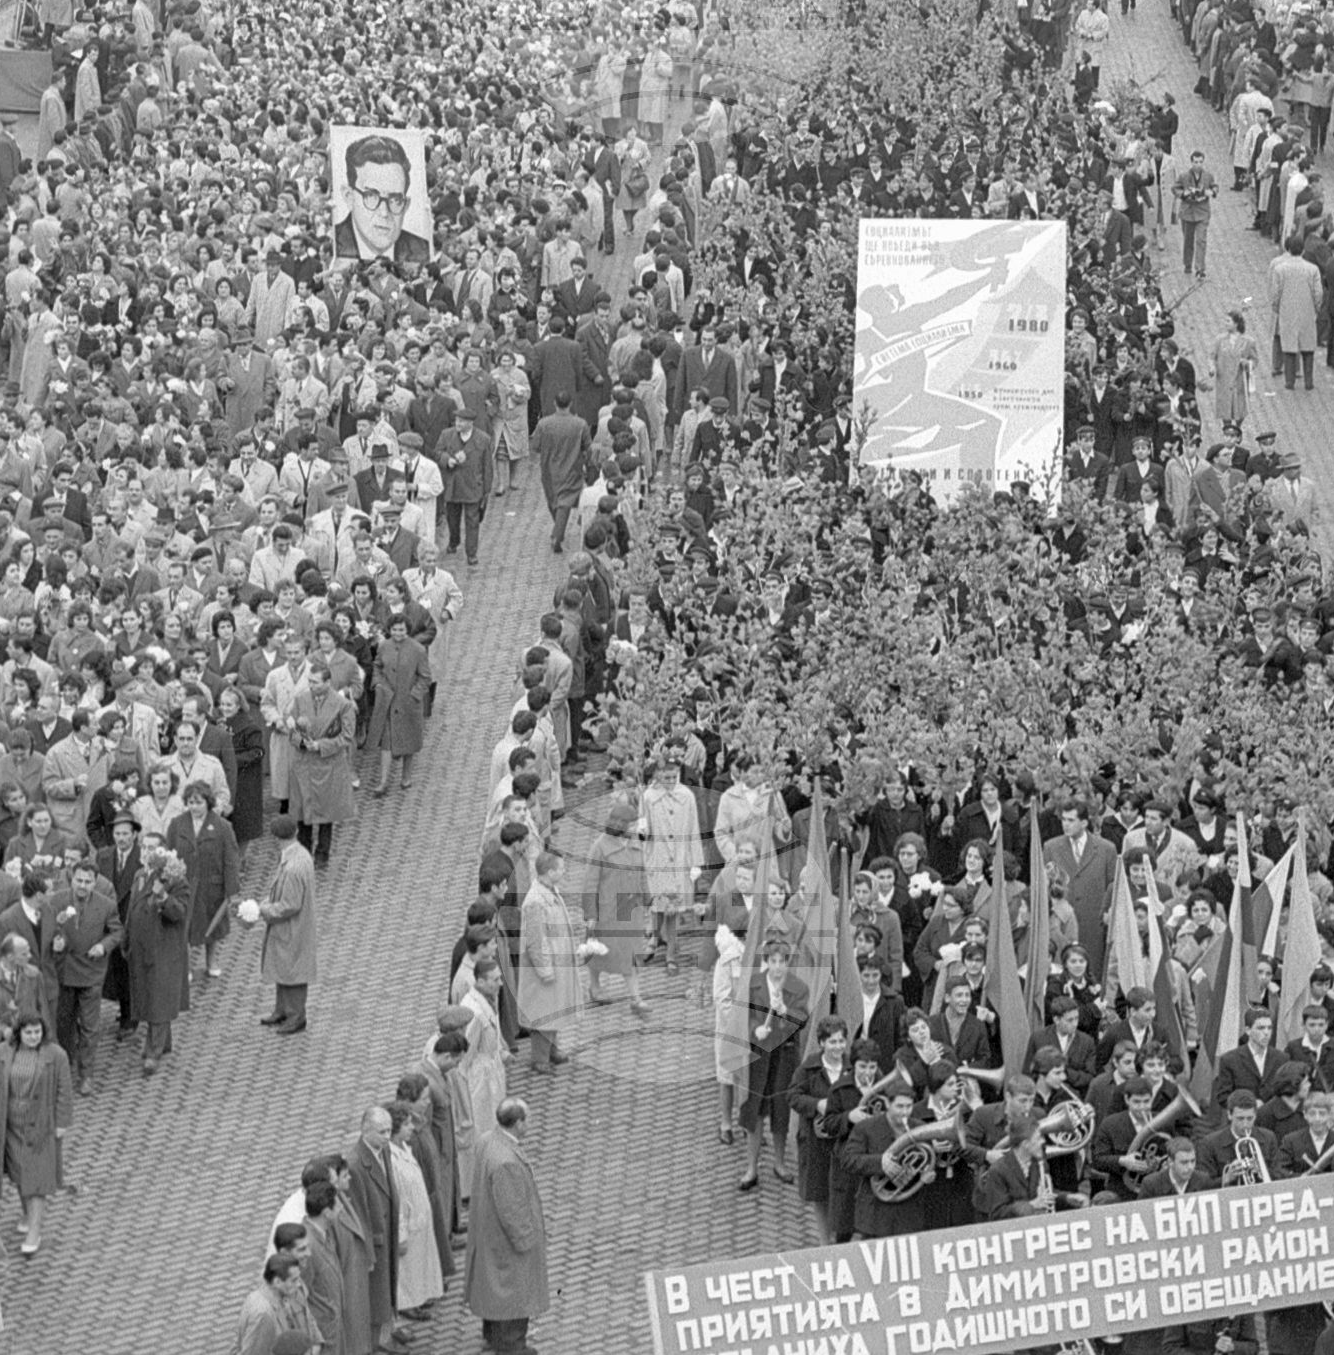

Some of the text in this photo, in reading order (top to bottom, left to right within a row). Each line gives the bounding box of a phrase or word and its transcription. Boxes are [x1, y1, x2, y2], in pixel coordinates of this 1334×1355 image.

[1008, 318, 1049, 333] 1980
[988, 361, 1018, 371] 1960
[666, 1191, 1334, 1315] В ЧЕСТ НА VIII КОНГРЕС НА БКП ПРЕД-
[676, 1294, 879, 1352] ПРИЯТИЯТА
[899, 1284, 922, 1317] В
[944, 1243, 1207, 1313] ДИМИТРОВСКИ
[1223, 1225, 1330, 1269] РАЙОН
[886, 1297, 1091, 1355] ГОДИШНОТО
[1105, 1290, 1147, 1324] СИ
